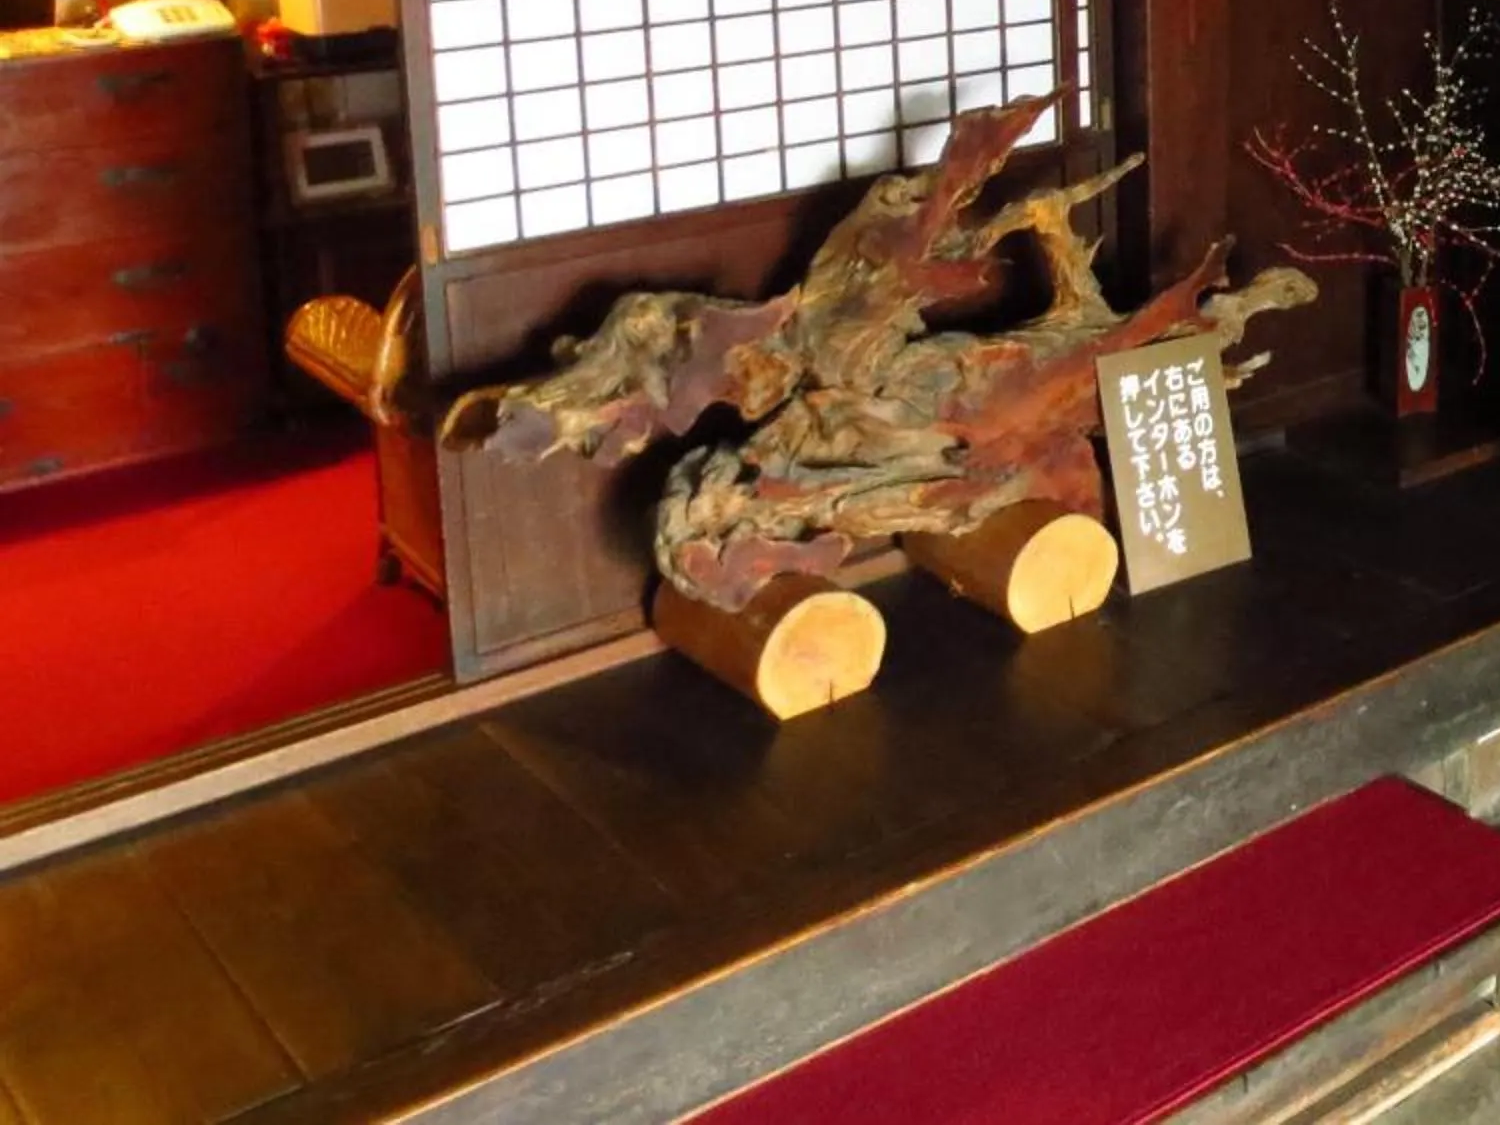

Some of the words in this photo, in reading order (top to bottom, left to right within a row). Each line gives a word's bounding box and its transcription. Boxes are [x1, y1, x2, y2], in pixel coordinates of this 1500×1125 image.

[1143, 369, 1188, 555] インターホンを
[1164, 365, 1197, 470] 右にある
